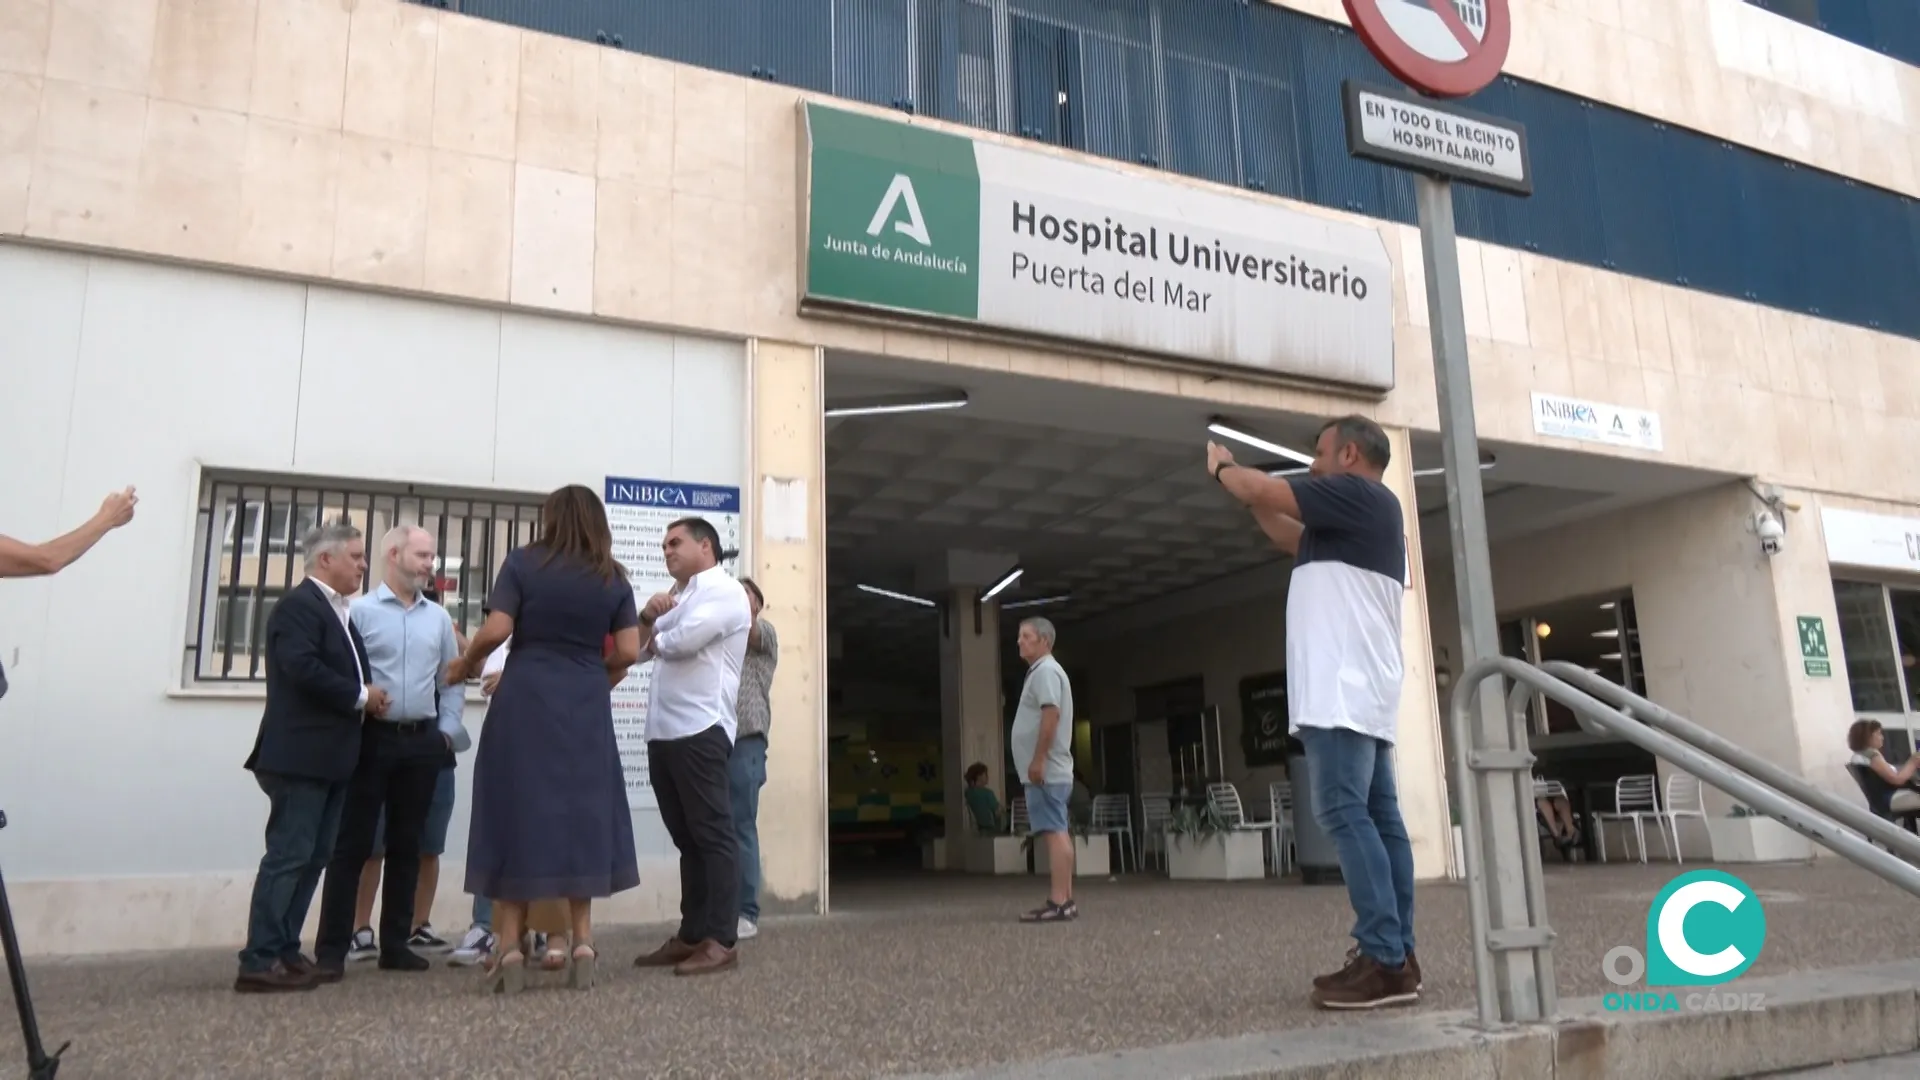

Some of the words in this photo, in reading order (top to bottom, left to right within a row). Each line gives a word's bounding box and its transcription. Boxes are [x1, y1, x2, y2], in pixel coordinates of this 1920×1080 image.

[1366, 100, 1385, 119] EN
[1391, 106, 1430, 130] TODO
[1435, 119, 1451, 136] EL
[1456, 124, 1515, 152] RECINTO
[1393, 128, 1495, 167] HOSPITALARIO
[823, 234, 868, 256] Junta
[872, 243, 890, 260] de
[894, 248, 967, 275] Andalucía
[1013, 200, 1158, 261] Hospital
[1169, 232, 1367, 300] Universitario
[1013, 251, 1104, 295] Puerta
[1114, 270, 1154, 303] del
[1164, 280, 1211, 313] Mar
